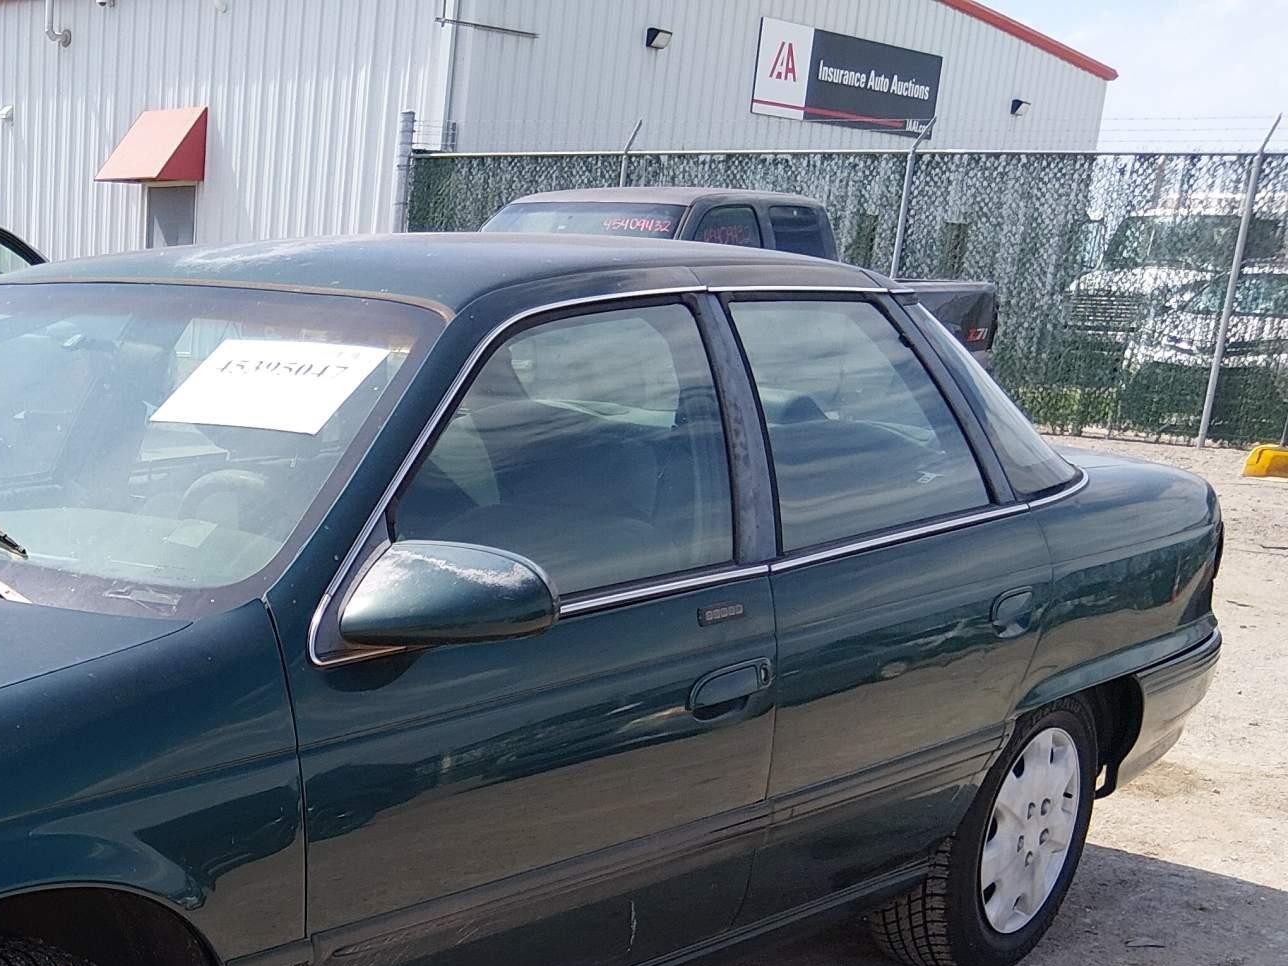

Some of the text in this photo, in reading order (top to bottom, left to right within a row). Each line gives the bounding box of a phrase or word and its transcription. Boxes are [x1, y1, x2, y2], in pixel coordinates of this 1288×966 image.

[818, 60, 930, 100] Insurance Auto Auctions
